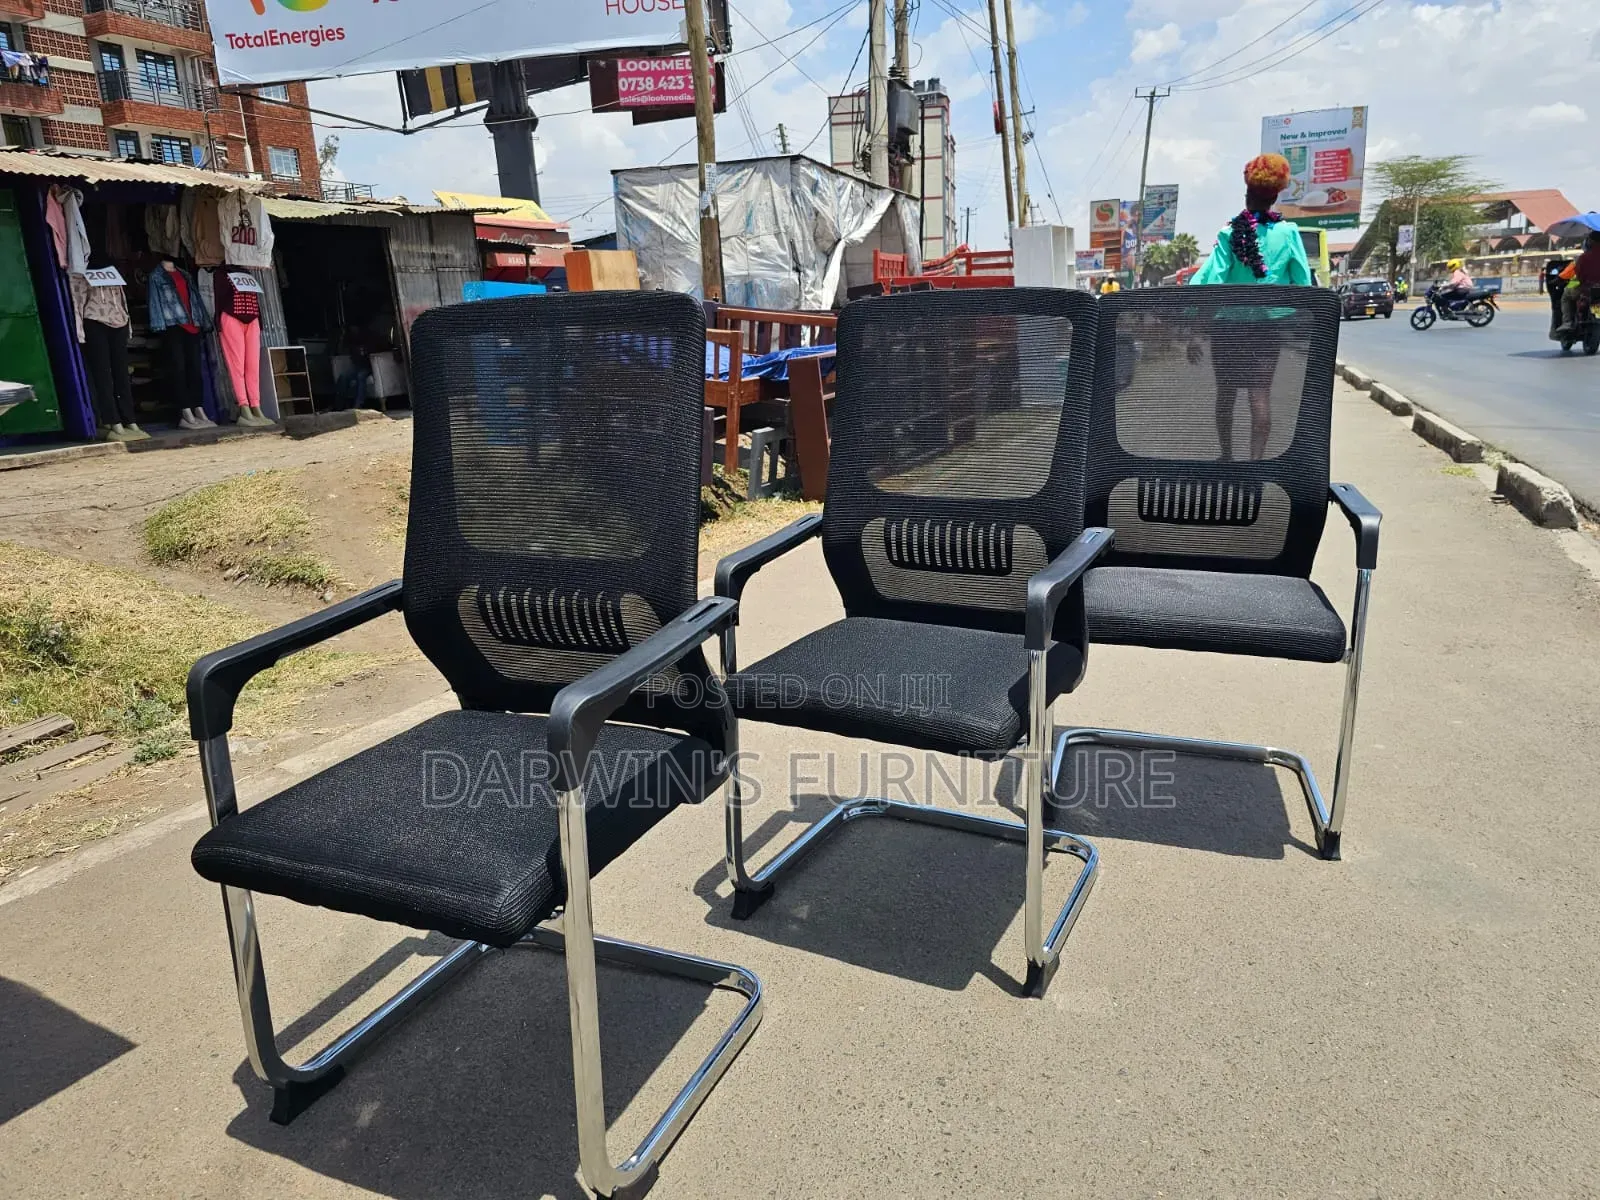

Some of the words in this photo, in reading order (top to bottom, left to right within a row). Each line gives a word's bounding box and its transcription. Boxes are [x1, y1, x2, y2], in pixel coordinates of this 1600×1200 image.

[225, 24, 346, 50] TotalEnergies
[617, 58, 714, 72] LOOKMED
[619, 77, 655, 91] 0738
[657, 74, 685, 90] 423
[1280, 132, 1299, 141] New
[231, 226, 257, 246] 200
[85, 270, 117, 281] 200
[235, 276, 258, 288] 200
